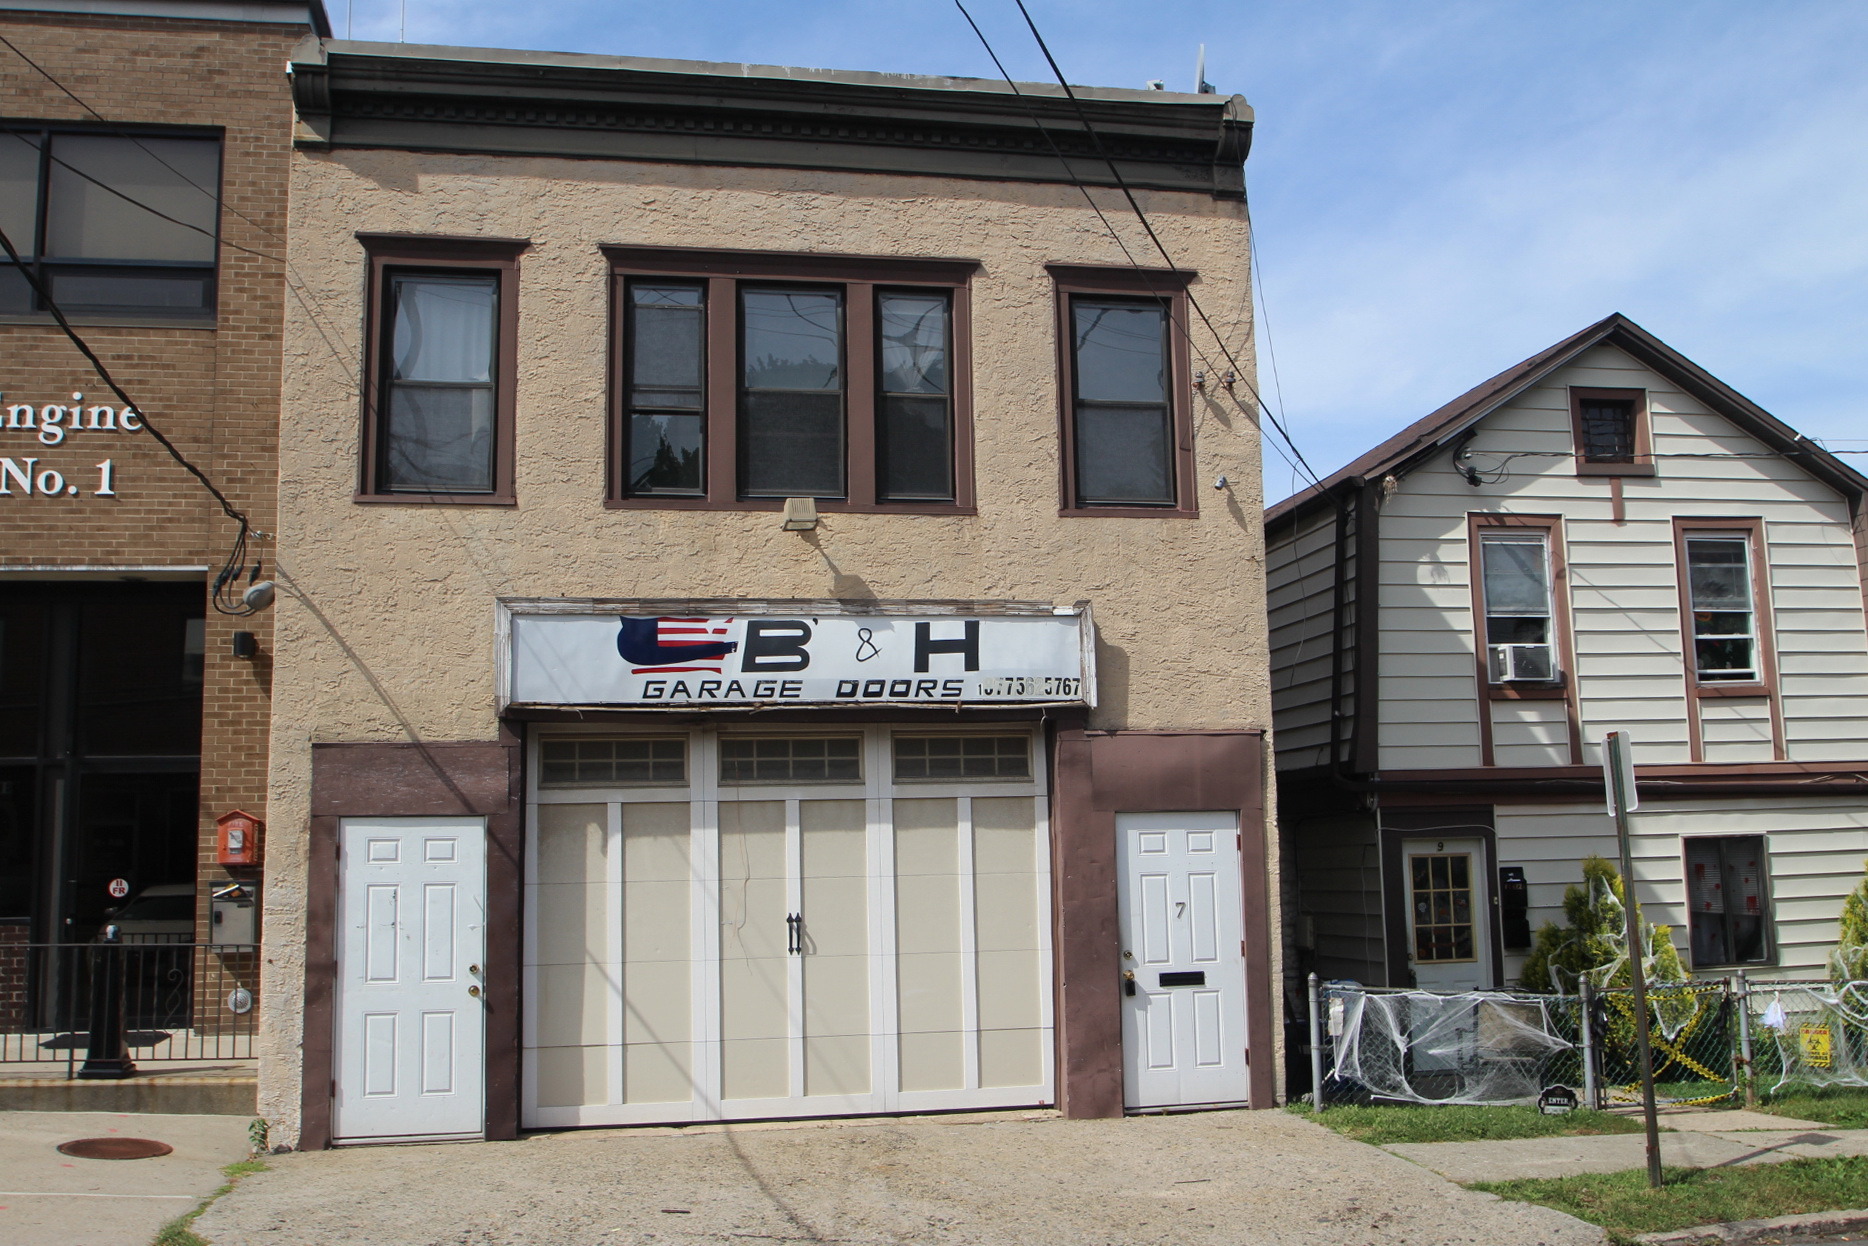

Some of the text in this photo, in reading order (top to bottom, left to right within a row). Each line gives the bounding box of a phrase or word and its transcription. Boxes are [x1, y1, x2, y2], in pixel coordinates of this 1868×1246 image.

[0, 391, 146, 445] ngine
[0, 457, 115, 495] No. 1
[855, 627, 882, 662] &
[914, 620, 979, 673] H
[642, 679, 964, 699] GARAGE DOORS
[1437, 841, 1444, 852] 9
[112, 887, 126, 895] FR
[1175, 901, 1187, 920] 7
